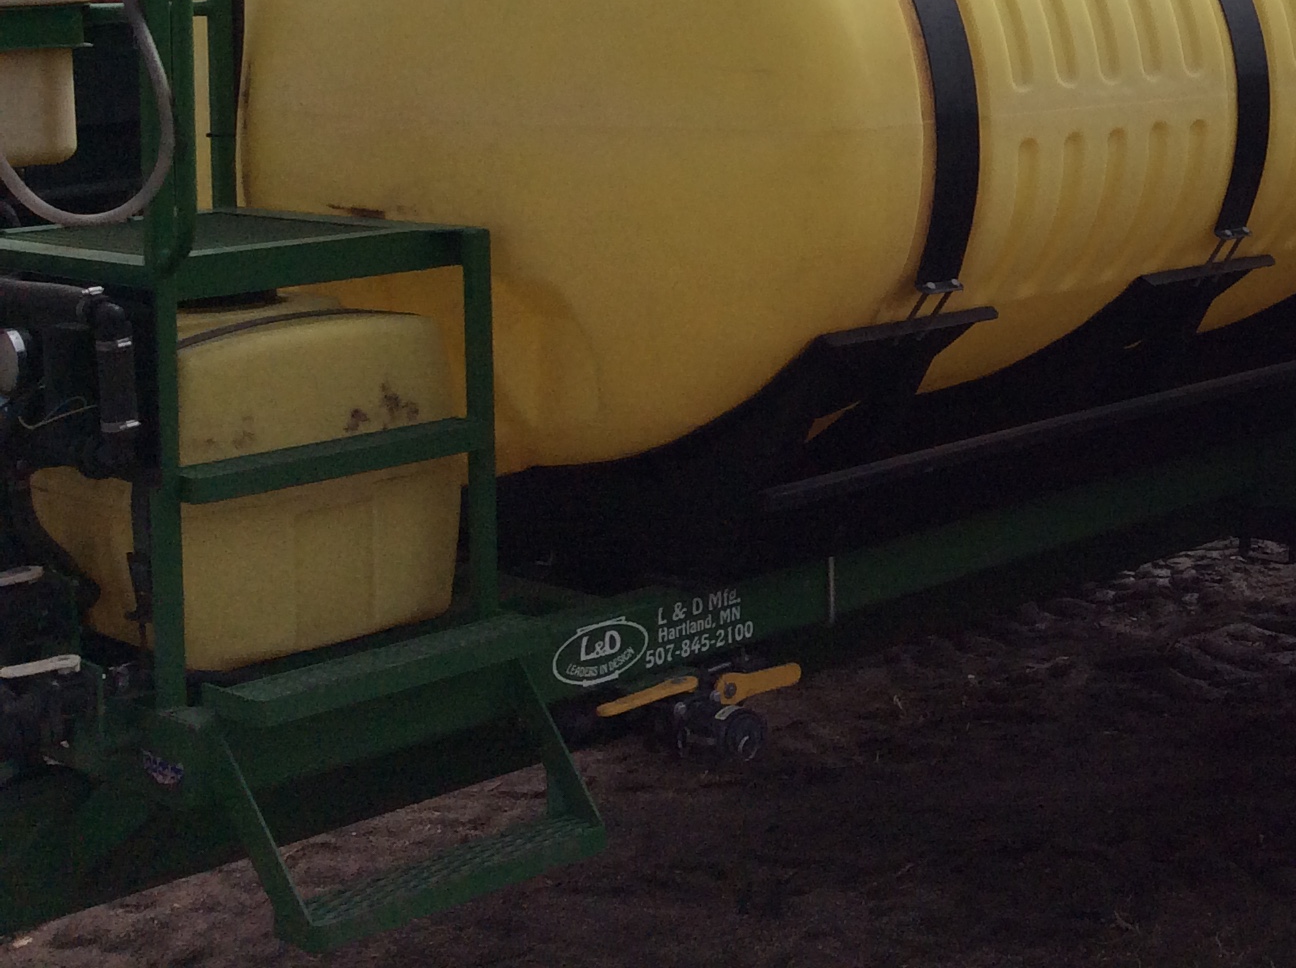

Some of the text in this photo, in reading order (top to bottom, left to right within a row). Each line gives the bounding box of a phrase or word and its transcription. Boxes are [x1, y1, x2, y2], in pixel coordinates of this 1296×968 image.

[658, 607, 667, 625] L
[672, 602, 687, 621] &
[692, 597, 704, 616] D
[658, 605, 742, 643] Hartland, MN
[580, 630, 621, 662] L&D
[608, 646, 636, 672] DESIGN
[645, 621, 754, 669] 507-845-2100
